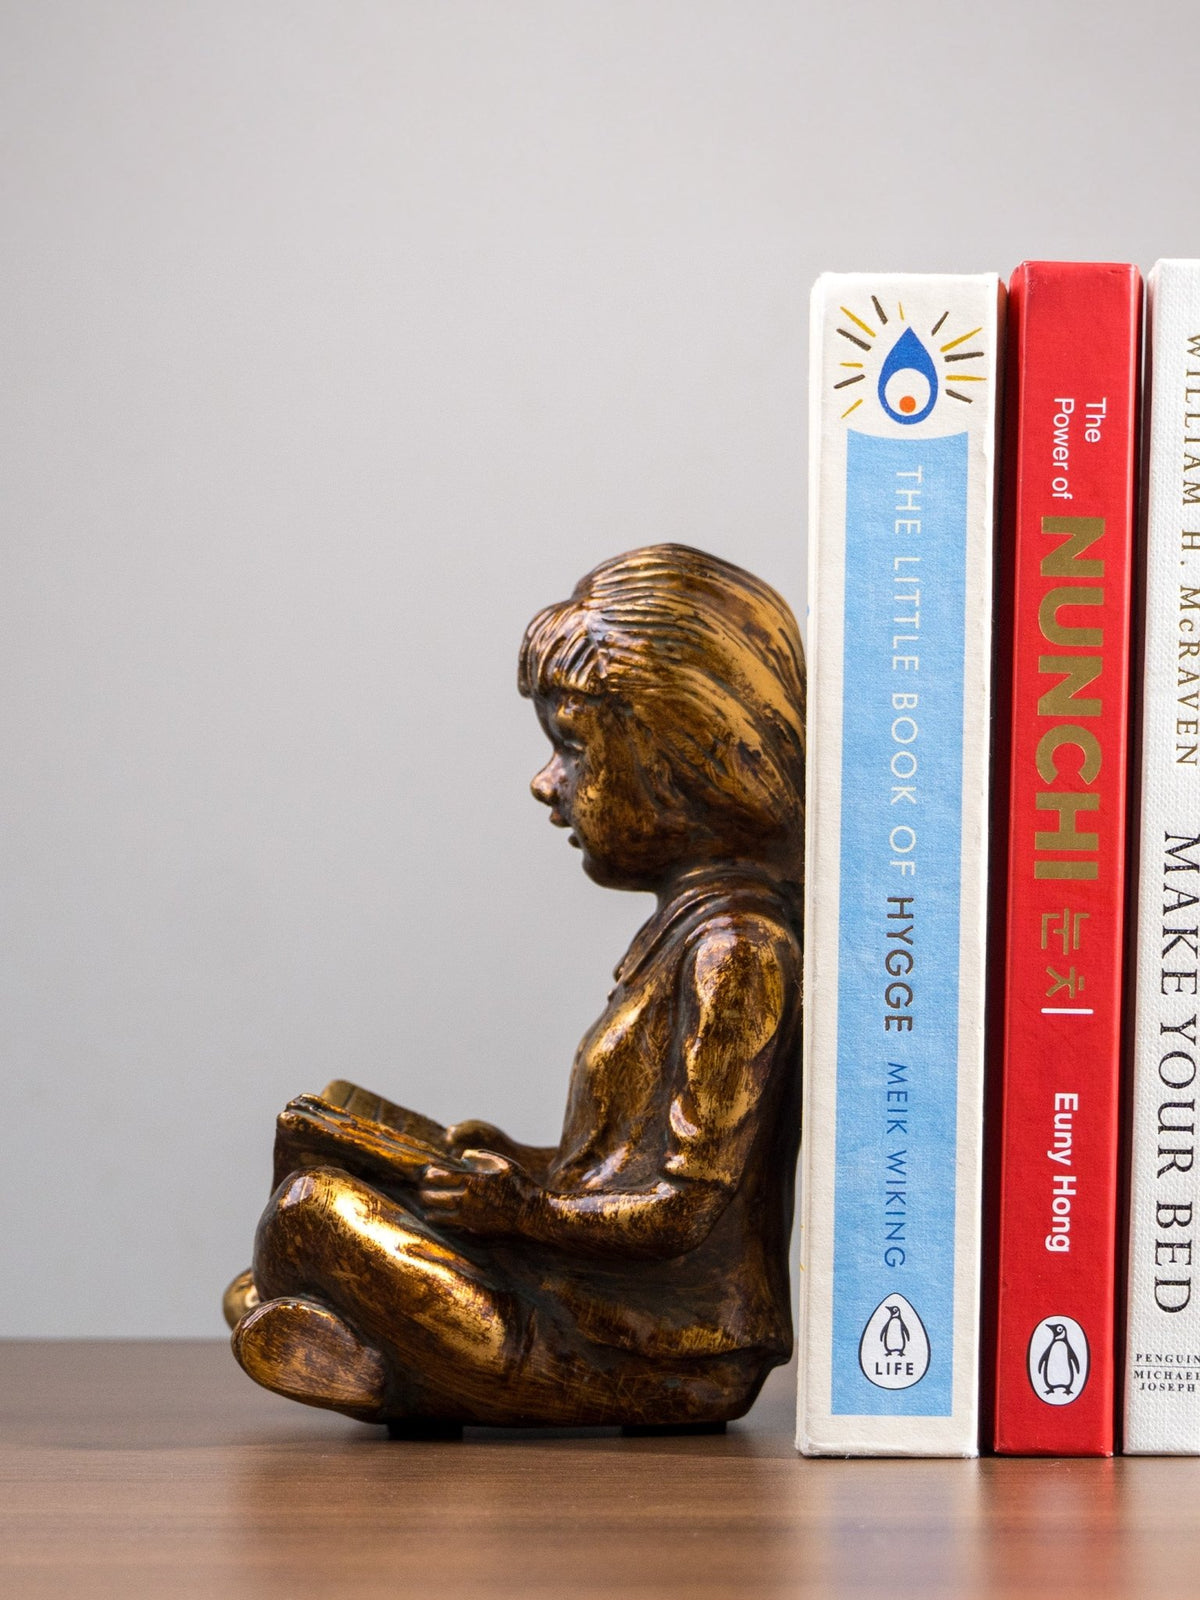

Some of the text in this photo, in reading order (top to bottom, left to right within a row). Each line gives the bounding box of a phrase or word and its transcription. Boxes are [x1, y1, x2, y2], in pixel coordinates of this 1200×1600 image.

[1051, 398, 1075, 500] Power of
[1084, 397, 1107, 443] The
[1175, 334, 1200, 766] WILLIAM H. McRAVEN
[884, 465, 923, 1032] THE LITTLE BOOK OF HYGGE
[1033, 516, 1106, 880] NUNCHI
[1153, 830, 1200, 1314] MAKE YOUR BED
[884, 1062, 909, 1268] MEIK WIKING
[1044, 1092, 1079, 1253] Euny Hong
[874, 1362, 915, 1377] LIFE
[1135, 1353, 1200, 1364] PENGUIN
[1139, 1382, 1196, 1392] JOSEPH
